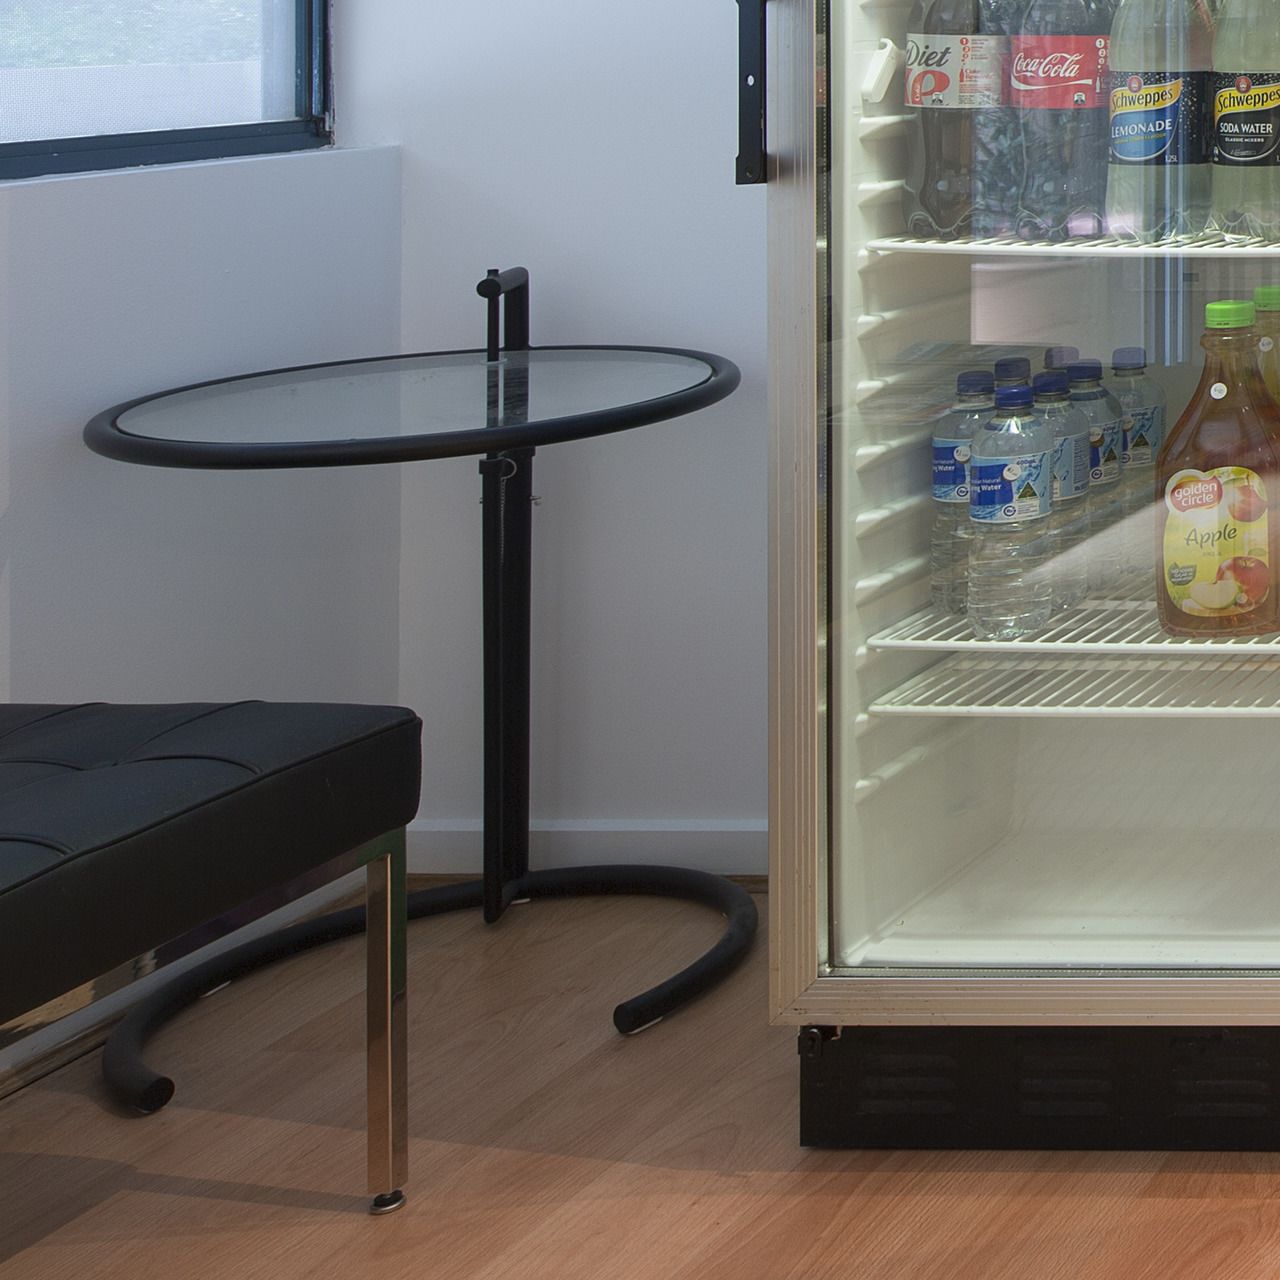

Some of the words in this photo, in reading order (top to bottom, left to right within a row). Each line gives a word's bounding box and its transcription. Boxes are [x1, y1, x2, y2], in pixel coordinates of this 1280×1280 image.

[906, 39, 951, 67] Diet
[1111, 88, 1173, 107] Schweppes
[1218, 89, 1280, 108] Schweppes
[1111, 120, 1172, 138] LEMONADE
[1220, 122, 1240, 134] SODA
[1242, 122, 1272, 134] WATER
[1175, 482, 1216, 496] golden
[1182, 494, 1213, 506] circle
[1185, 525, 1237, 548] Apple
